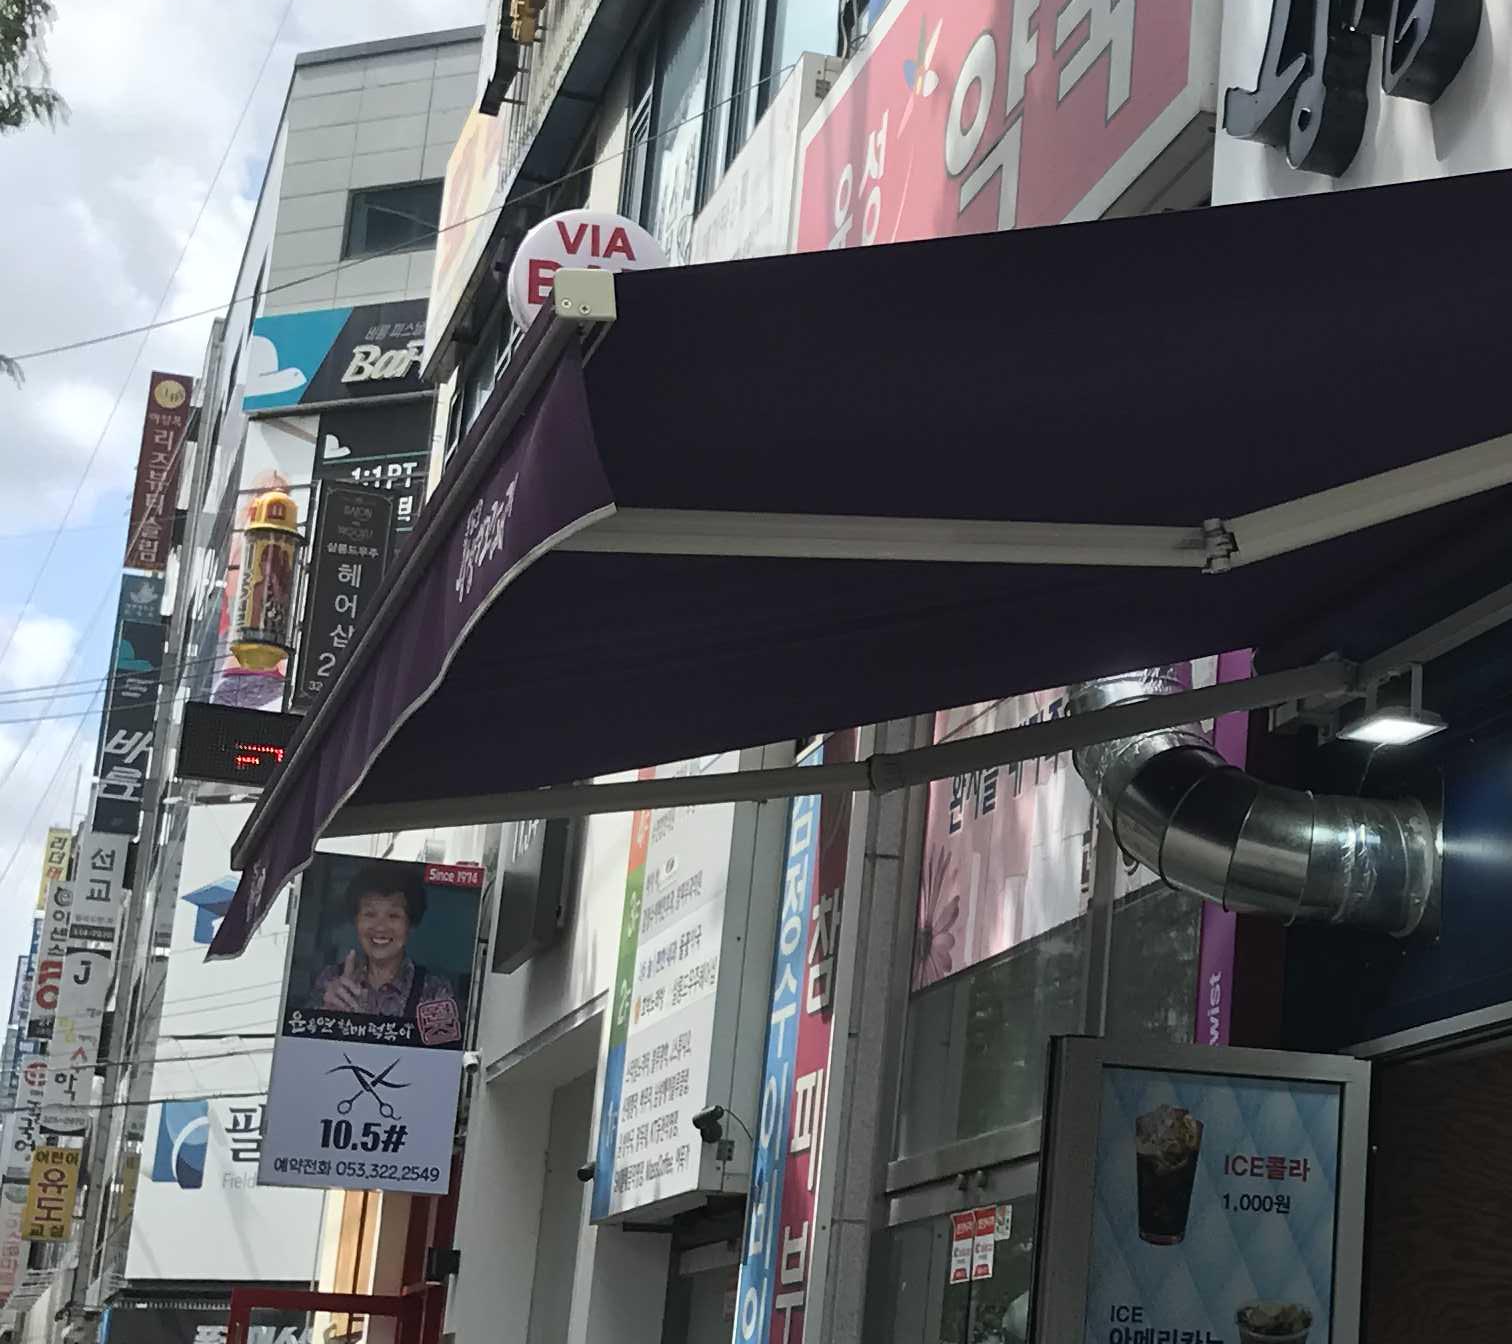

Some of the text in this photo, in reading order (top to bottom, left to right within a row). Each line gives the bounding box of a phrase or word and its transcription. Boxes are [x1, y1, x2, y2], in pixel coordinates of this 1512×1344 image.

[556, 220, 637, 262] VIA
[429, 867, 455, 883] Since
[1207, 970, 1223, 1046] wist
[319, 1118, 409, 1153] 10.5#
[273, 1157, 332, 1176] 예약전화
[1222, 1154, 1312, 1183] ICE콜라
[1221, 1192, 1292, 1216] 1,000원
[1109, 1304, 1144, 1324] ICE
